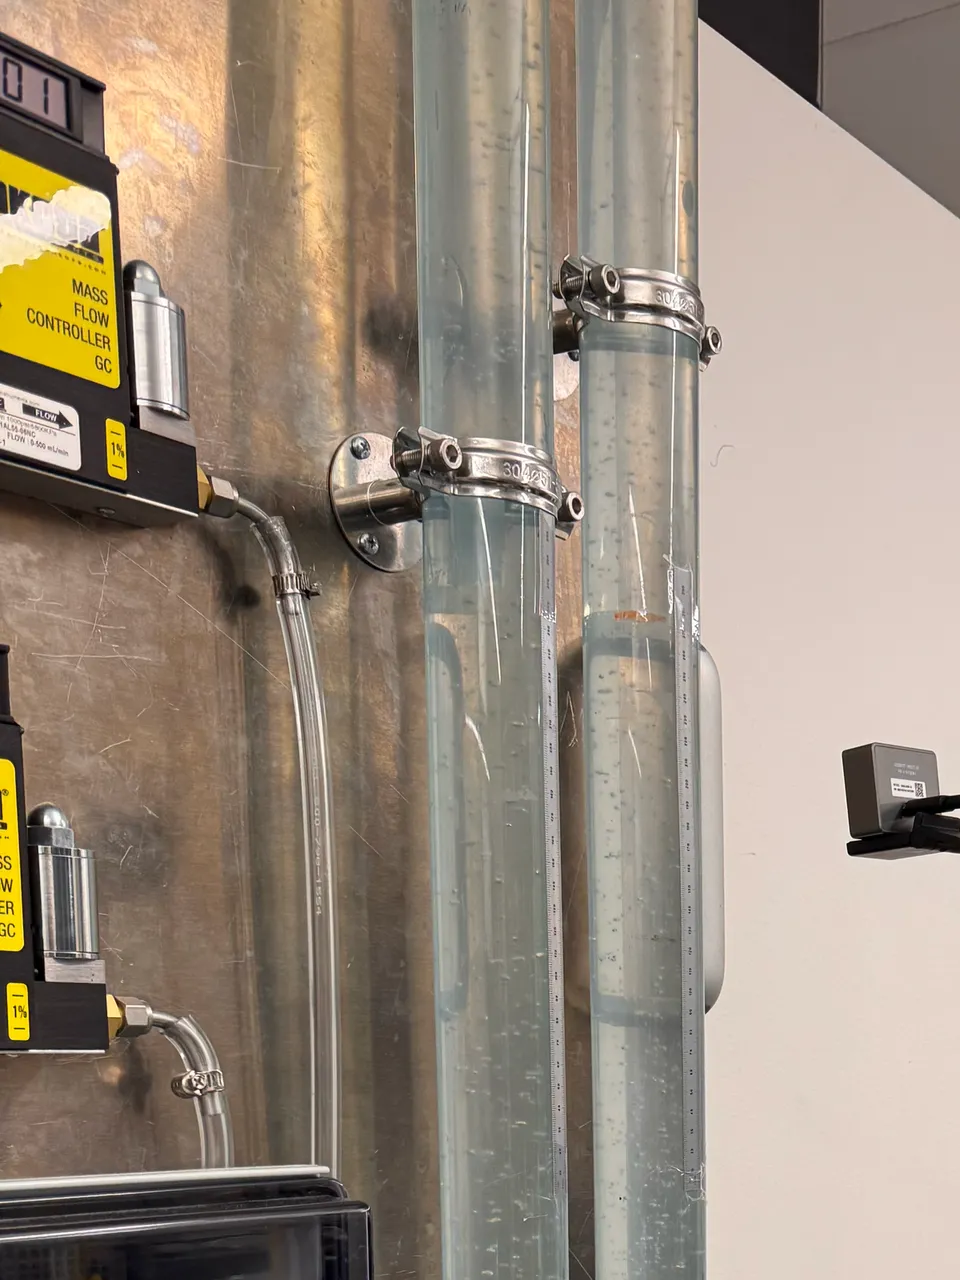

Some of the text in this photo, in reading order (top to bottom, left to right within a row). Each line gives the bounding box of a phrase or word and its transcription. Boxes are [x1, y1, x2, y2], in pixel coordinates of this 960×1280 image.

[72, 278, 108, 305] MASS
[74, 302, 109, 328] FLOW
[26, 307, 111, 352] CONTROLLER
[94, 355, 112, 374] GC
[35, 408, 57, 422] FLOW
[111, 442, 125, 459] 1%
[12, 1005, 27, 1019] 1%
